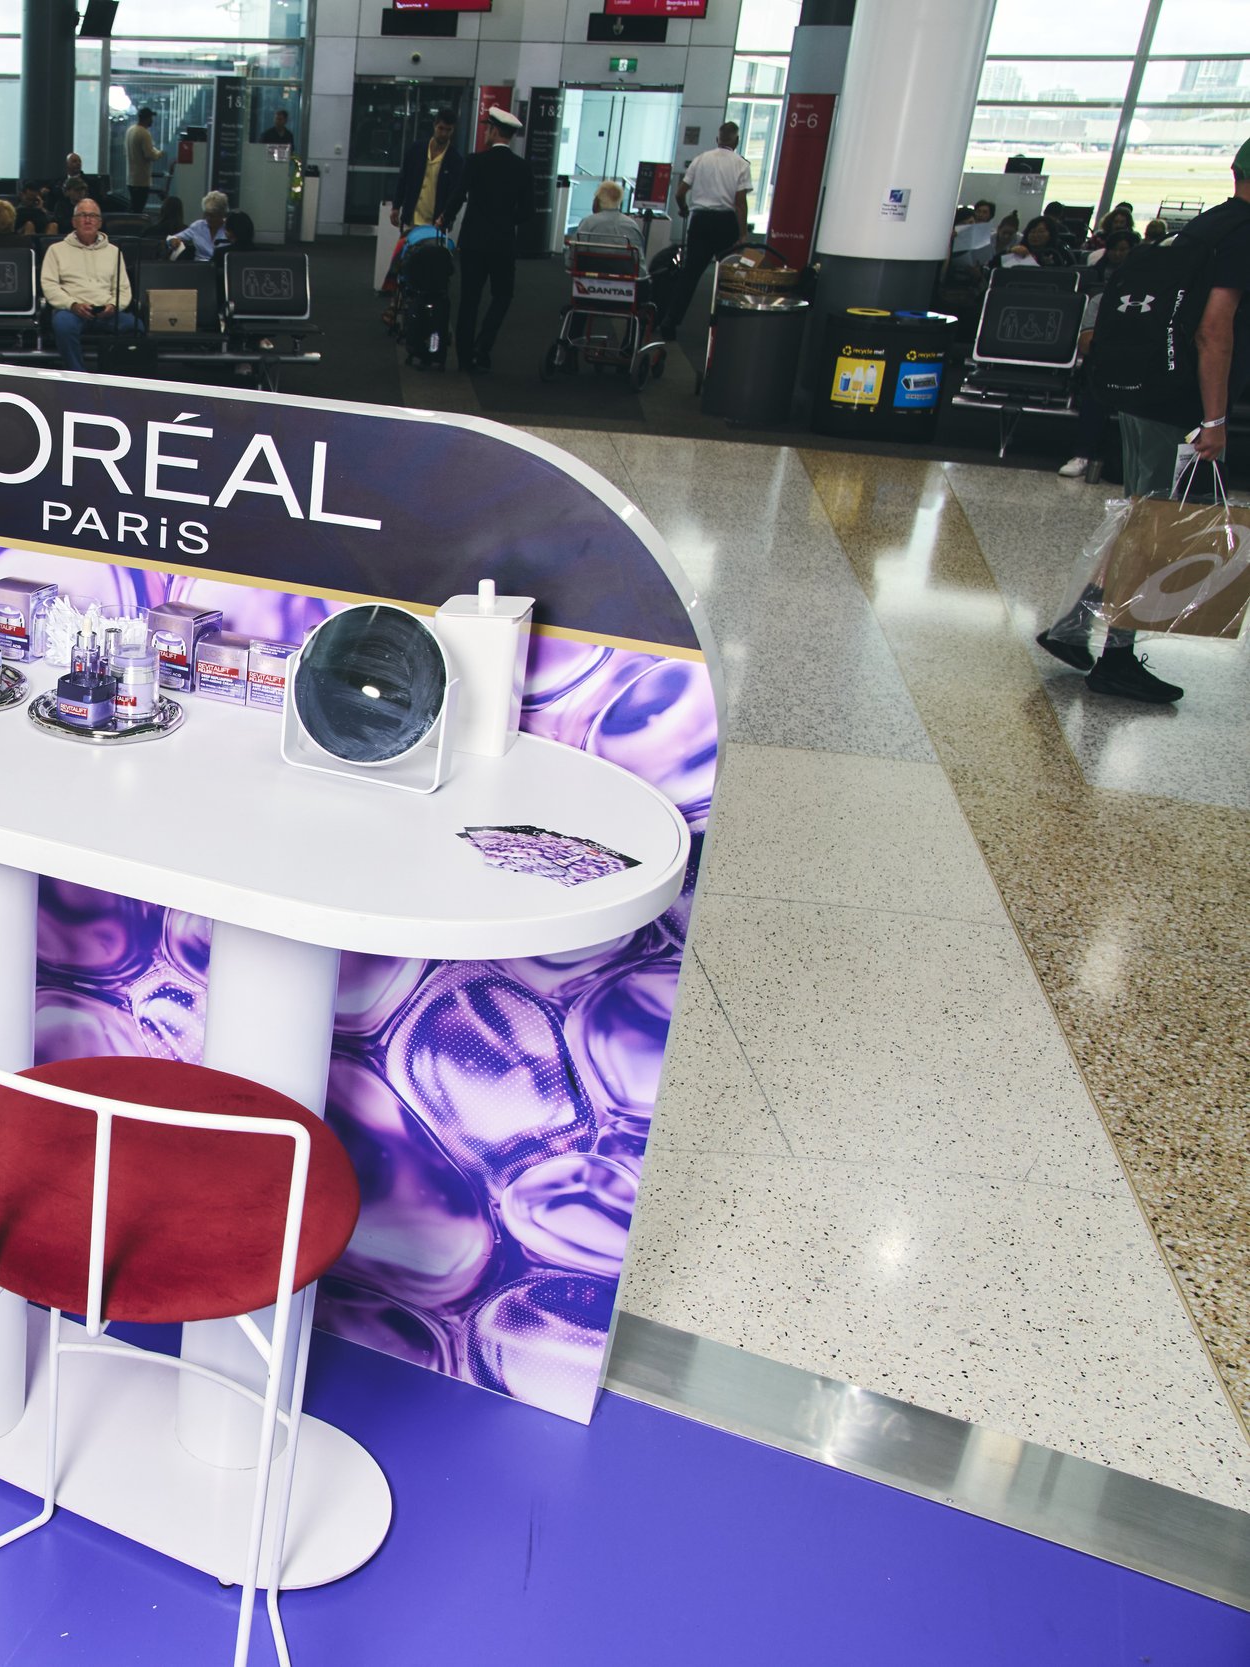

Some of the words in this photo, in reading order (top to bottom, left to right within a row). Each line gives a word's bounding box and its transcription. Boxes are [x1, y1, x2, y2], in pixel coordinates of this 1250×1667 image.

[587, 285, 633, 297] QANTAS
[853, 347, 873, 355] recycle
[197, 662, 231, 673] REVITALIFT
[248, 672, 283, 683] REVITALIFT
[60, 703, 88, 715] REVITALIFT
